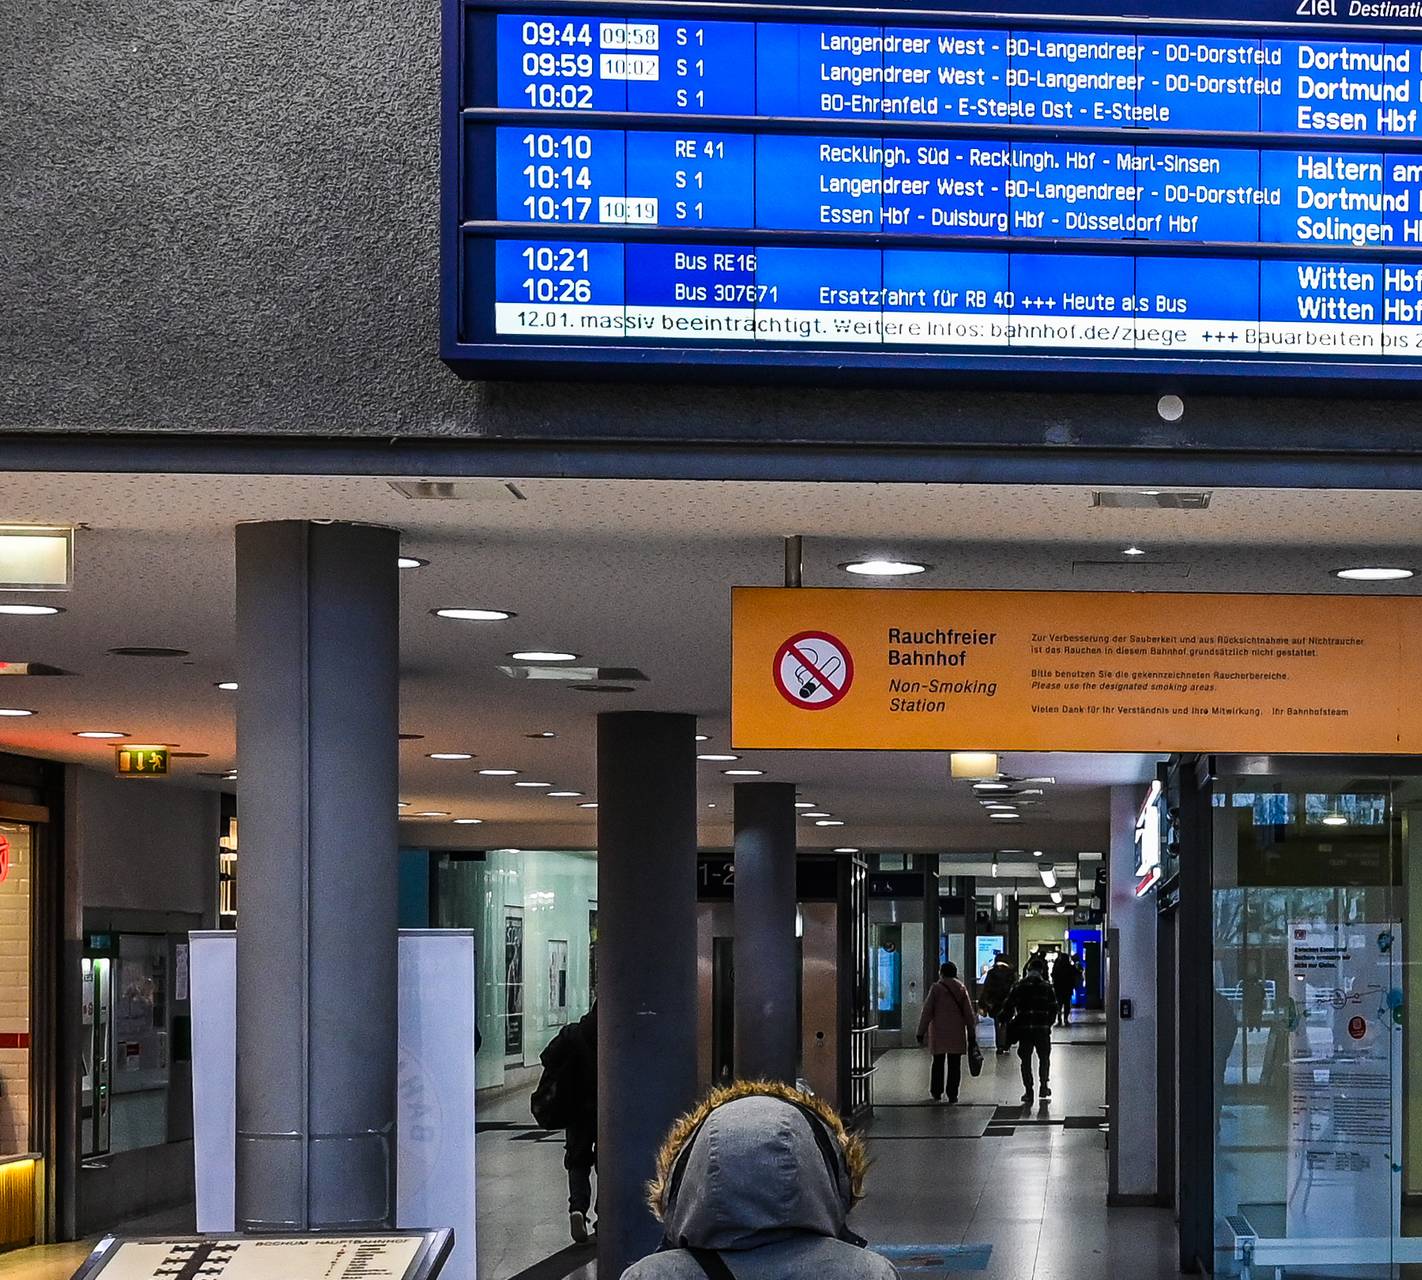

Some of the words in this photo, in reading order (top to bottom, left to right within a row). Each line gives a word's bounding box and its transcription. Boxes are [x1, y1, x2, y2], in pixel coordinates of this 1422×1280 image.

[1296, 0, 1337, 17] Ziel
[522, 22, 592, 47] 09:44
[603, 28, 656, 45] 09:58
[676, 28, 688, 46] S
[695, 28, 704, 46] 1
[821, 32, 930, 55] Langendreer
[938, 36, 985, 55] West
[1006, 39, 1145, 62] BO-Langendreer
[1166, 44, 1282, 65] DO-Dorstfeld
[1298, 45, 1409, 73] Dortmund
[522, 53, 593, 77] 09:59
[606, 59, 656, 77] 10:02
[676, 59, 688, 77] S
[695, 59, 704, 77] 1
[821, 63, 931, 86] Langendreer
[938, 67, 985, 86] West
[1006, 70, 1145, 93] BO-Langendreer
[1166, 74, 1282, 95] DO-Dorstfeld
[1298, 75, 1409, 103] Dortmund
[525, 84, 593, 109] 10:02
[676, 89, 688, 107] S
[695, 90, 704, 107] 1
[821, 94, 938, 114] BO-Ehrenfeld
[959, 98, 1035, 118] E-Steele
[1042, 100, 1072, 119] Ost
[1094, 102, 1169, 122] E-Steele
[1297, 106, 1367, 131] Essen
[1377, 109, 1417, 133] Hbf
[523, 134, 592, 159] 10:10
[675, 140, 697, 158] RE
[703, 141, 724, 160] 41
[820, 144, 910, 167] Recklingh.
[917, 146, 949, 165] Süd
[970, 148, 1059, 172] Recklingh.
[1066, 151, 1096, 170] Hbf
[1116, 152, 1220, 174] Marl-Sinsen
[1297, 156, 1383, 183] Haltern
[523, 165, 592, 190] 10:14
[675, 171, 687, 189] S
[694, 171, 703, 189] 1
[820, 174, 930, 198] Langendreer
[937, 178, 984, 197] West
[1005, 180, 1144, 204] BO-Langendreer
[1165, 185, 1281, 206] DO-Dorstfeld
[1297, 186, 1409, 212] Dortmund
[523, 196, 592, 220] 10:17
[604, 202, 655, 218] 10:19
[675, 201, 687, 219] S
[694, 202, 703, 219] 1
[820, 205, 873, 224] Essen
[880, 207, 910, 225] Hbf
[931, 208, 1008, 231] Duisburg
[1015, 210, 1044, 229] Hbf
[1065, 211, 1162, 231] Düsseldorf
[1169, 215, 1198, 233] Hbf
[1296, 216, 1393, 246] Solingen
[522, 247, 589, 272] 10:21
[675, 253, 707, 271] Bus
[714, 254, 757, 272] RE16
[1297, 265, 1374, 291] Witten
[522, 278, 592, 302] 10:26
[675, 283, 707, 301] Bus
[714, 284, 778, 303] 307671
[819, 287, 926, 307] Ersatzfahrt
[933, 289, 958, 307] für
[965, 290, 987, 308] RB
[993, 290, 1015, 309] 40
[1063, 293, 1115, 312] Heute
[1156, 295, 1187, 313] Bus
[1297, 295, 1374, 321] Witten
[518, 311, 574, 328] 12.01.
[581, 315, 654, 330] massiv
[834, 318, 921, 336] Weitere
[1245, 328, 1374, 347] Bauarbeiten
[1381, 332, 1408, 348] bis
[889, 628, 997, 645] Rauchfreier
[889, 650, 967, 666] Bahnhof
[889, 678, 997, 697] Non-Smoking
[889, 697, 946, 712] Station
